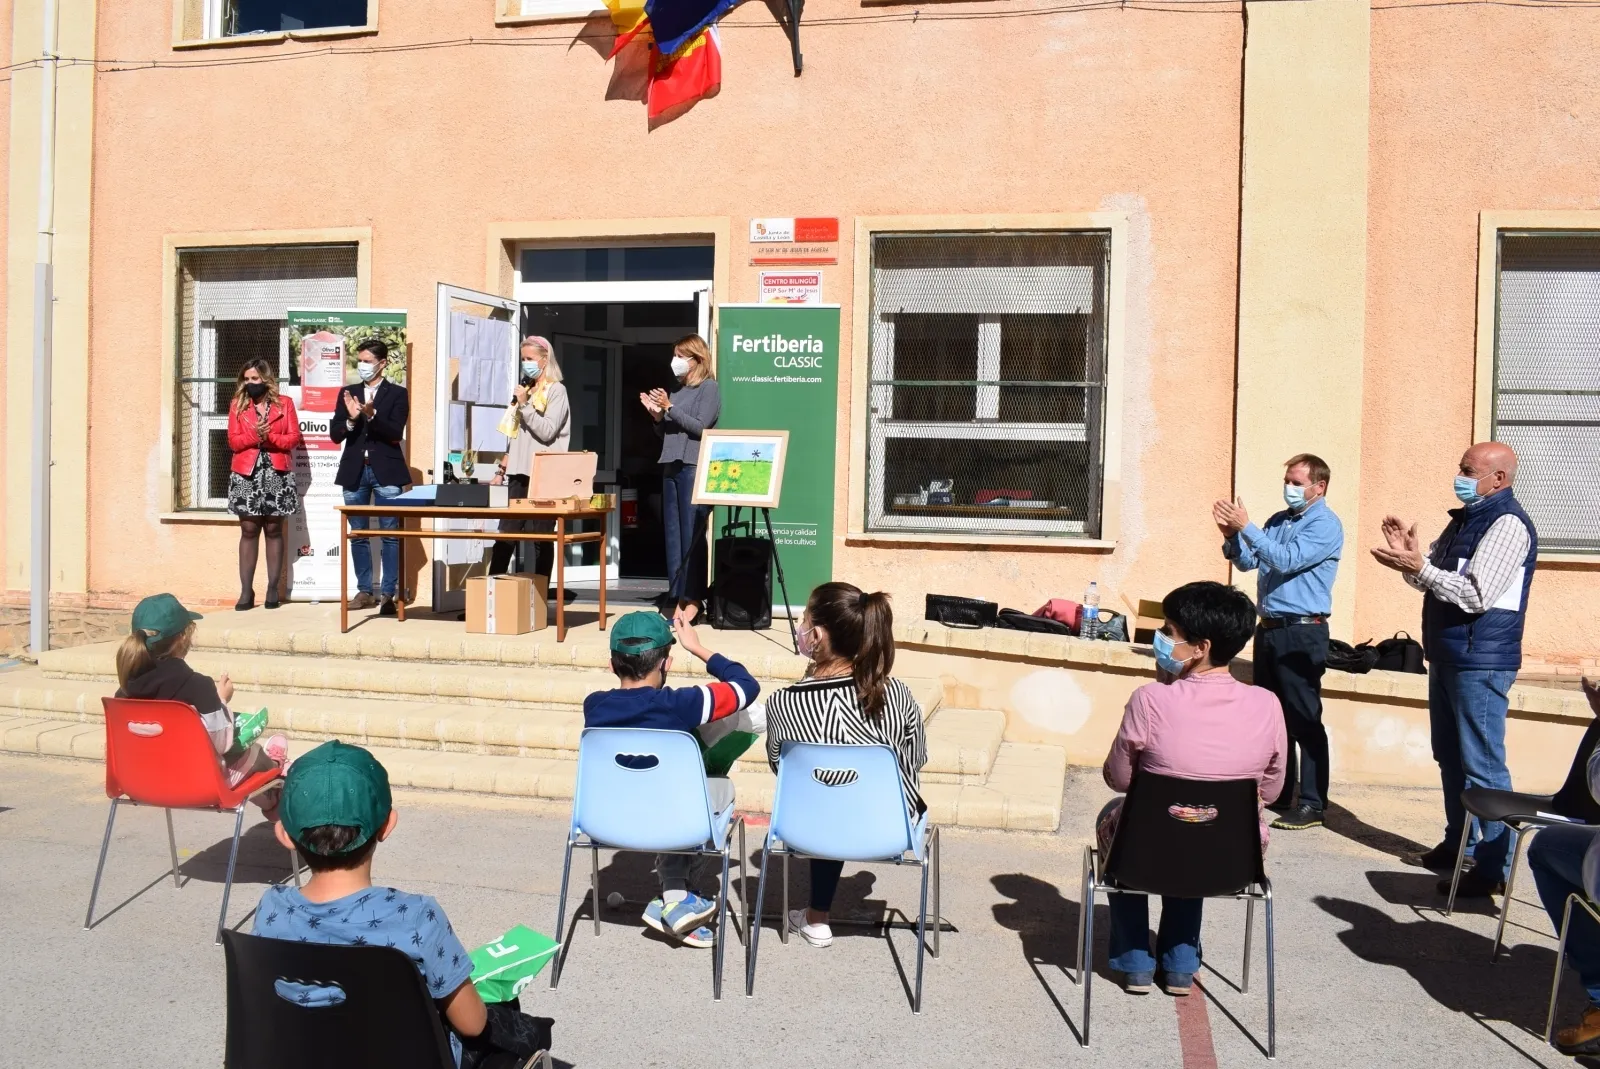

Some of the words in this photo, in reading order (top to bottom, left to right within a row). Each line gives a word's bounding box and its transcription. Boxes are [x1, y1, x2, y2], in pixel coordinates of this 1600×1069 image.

[732, 334, 824, 353] Fertiberia
[773, 356, 823, 368] CLASSIC
[732, 375, 822, 383] www.classic.fertiberia.com
[299, 421, 327, 432] Olivo
[794, 528, 817, 536] calidad
[793, 538, 817, 546] cultivos
